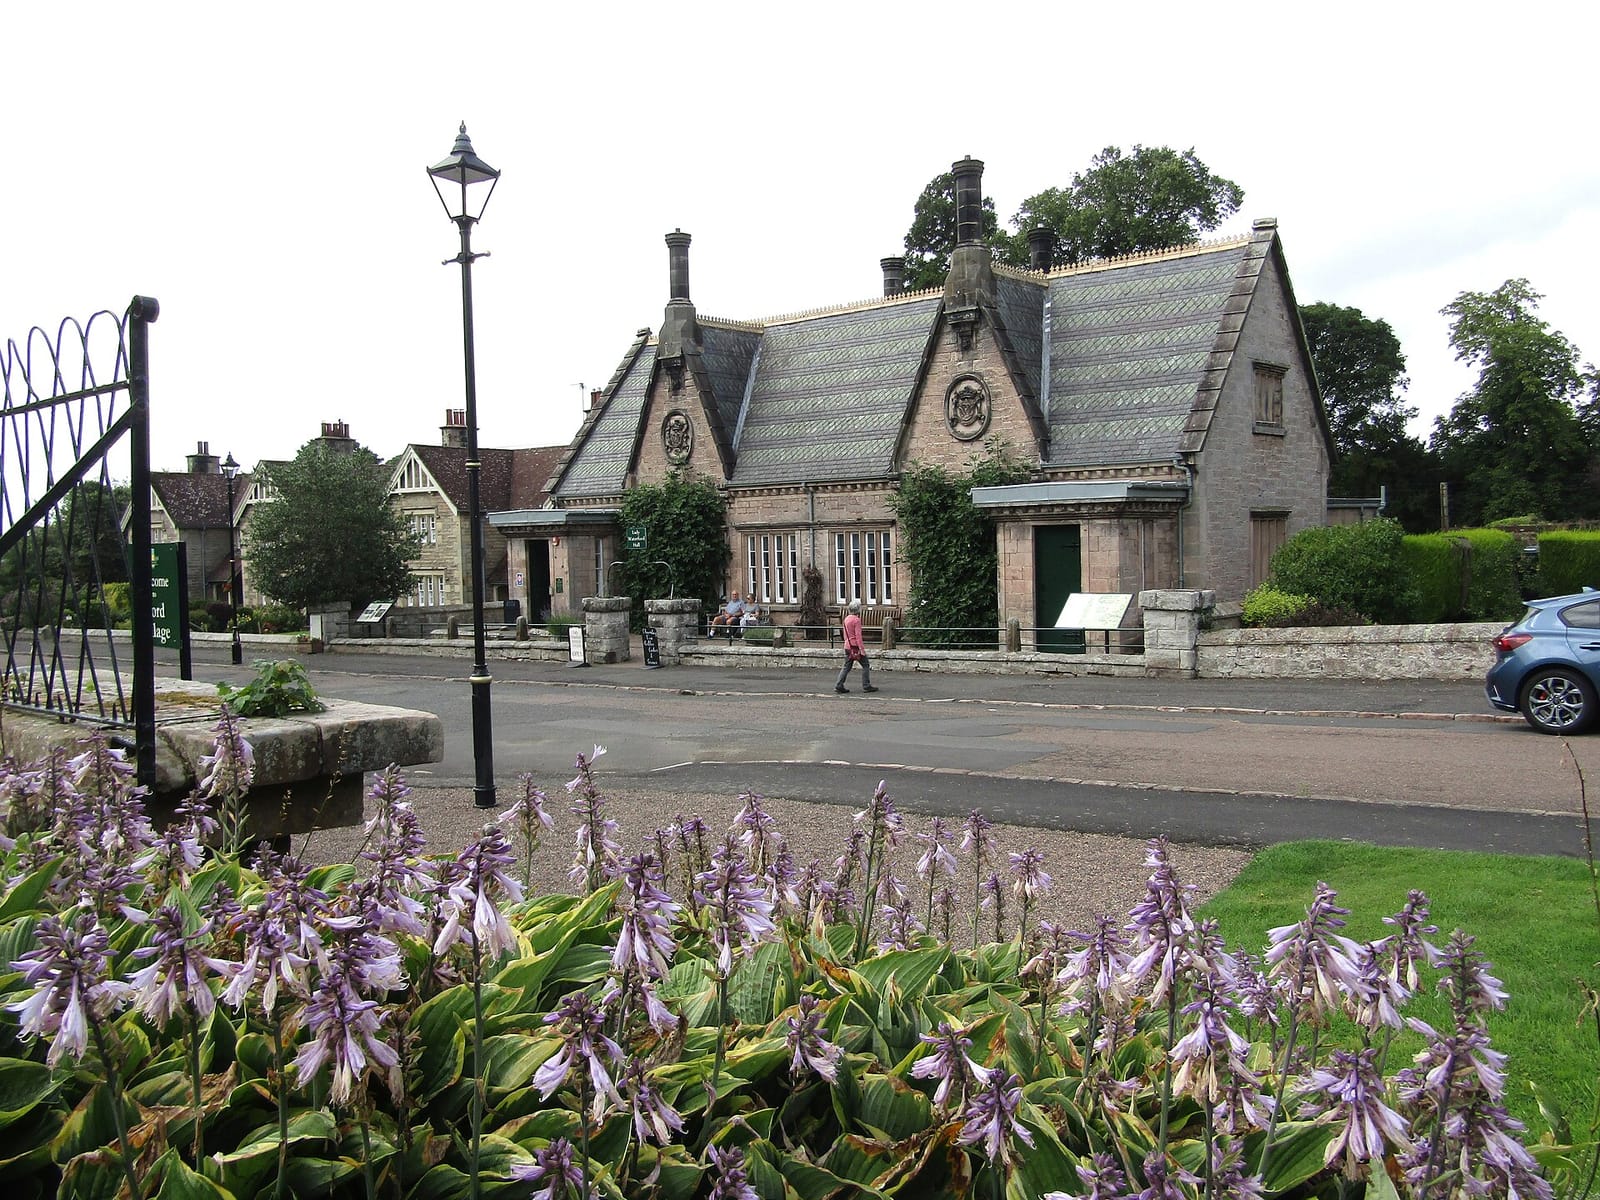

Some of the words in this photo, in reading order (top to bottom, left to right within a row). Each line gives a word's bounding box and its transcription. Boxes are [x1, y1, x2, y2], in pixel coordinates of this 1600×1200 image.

[151, 577, 169, 587] come
[151, 602, 166, 618] ord
[152, 622, 171, 644] lage
